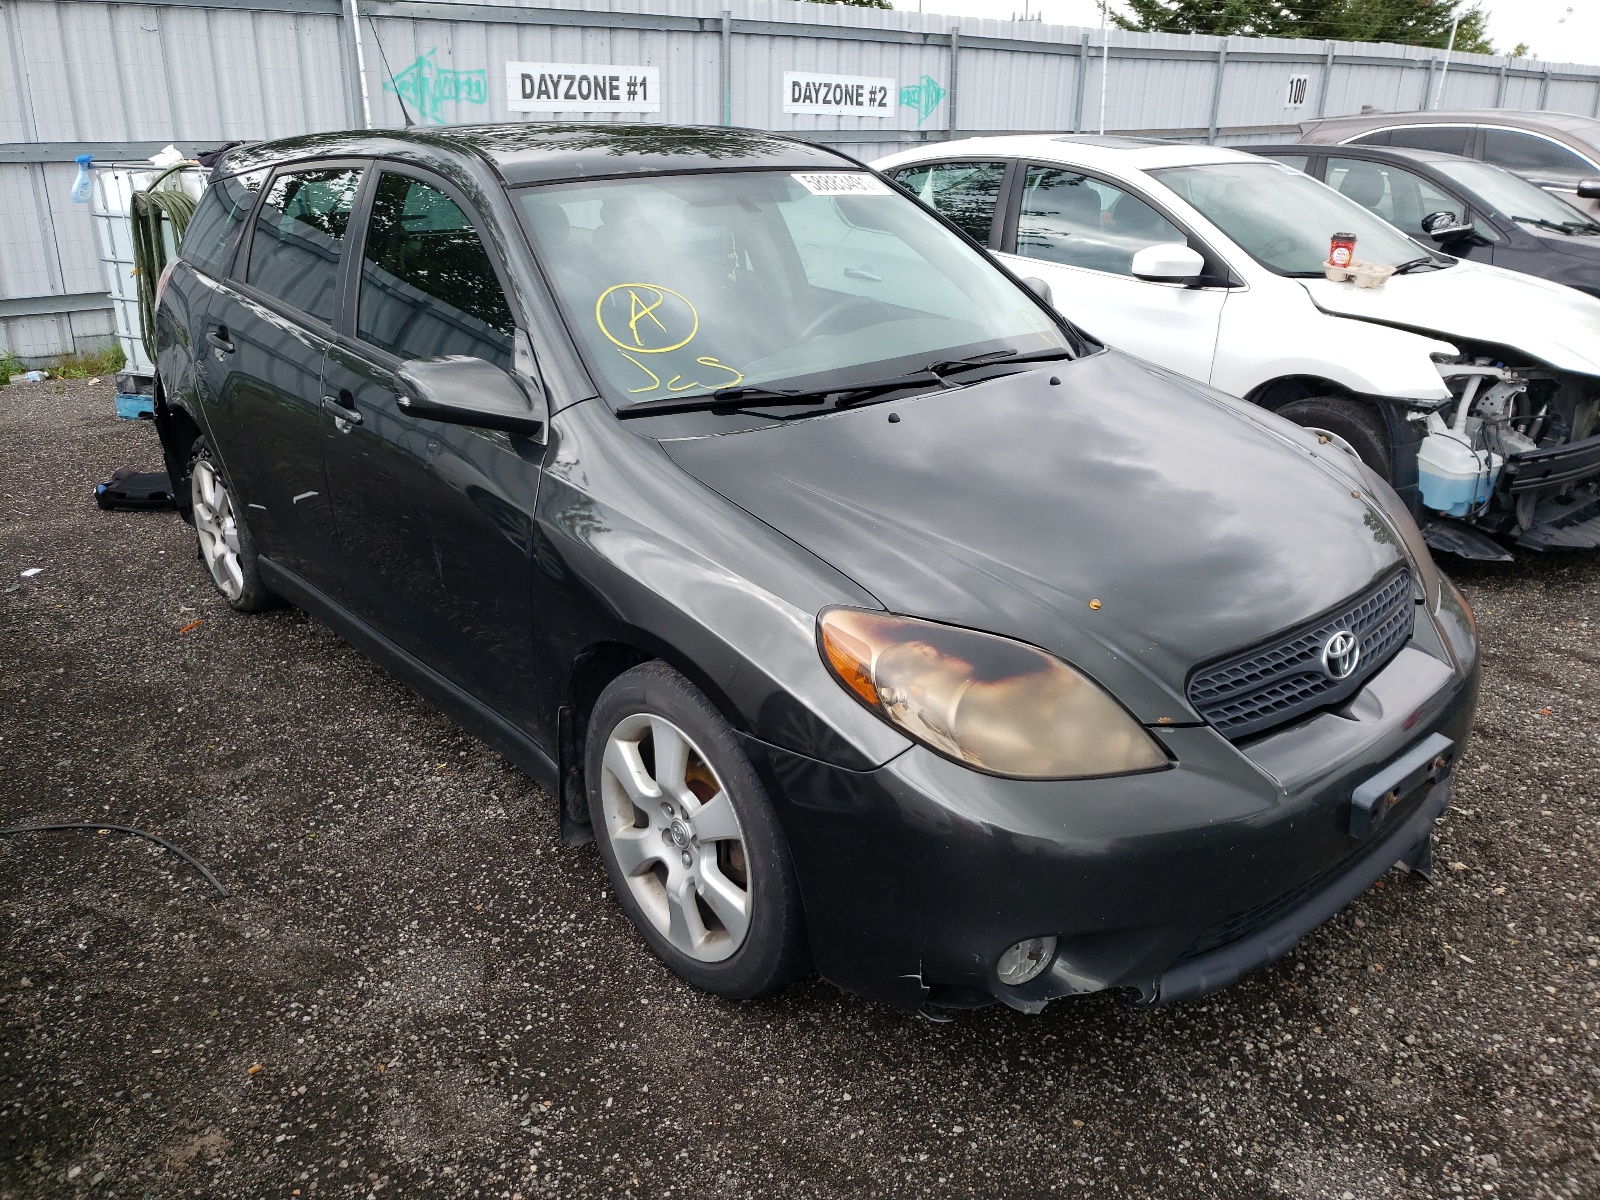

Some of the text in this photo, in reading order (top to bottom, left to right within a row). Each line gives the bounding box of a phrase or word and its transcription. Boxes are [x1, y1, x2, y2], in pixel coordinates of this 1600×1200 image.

[520, 73, 648, 101] DAYZONE #1
[791, 80, 888, 107] DAYZONE #2
[1288, 78, 1307, 104] 100
